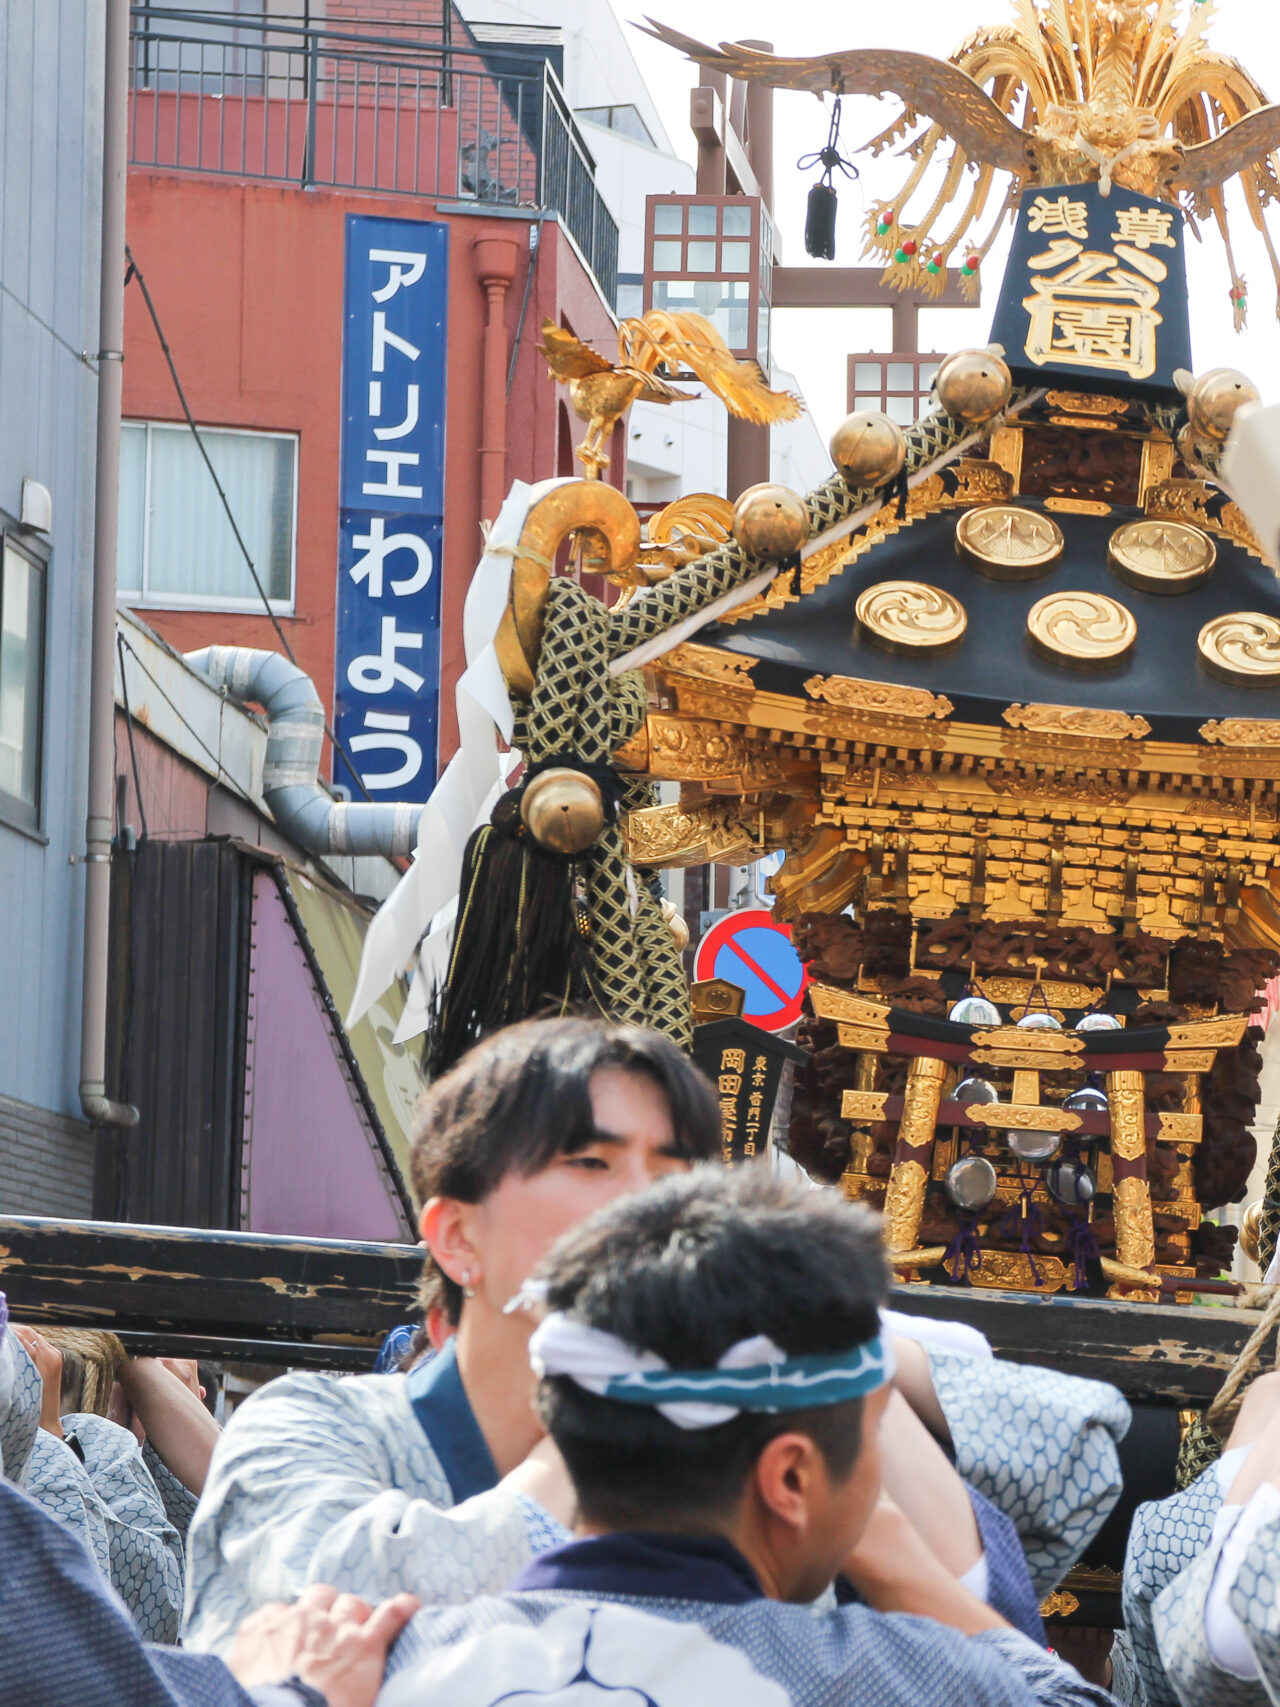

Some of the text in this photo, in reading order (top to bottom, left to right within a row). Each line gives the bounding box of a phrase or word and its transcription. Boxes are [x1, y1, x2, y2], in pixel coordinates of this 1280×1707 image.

[347, 249, 432, 790] アトリエわよう
